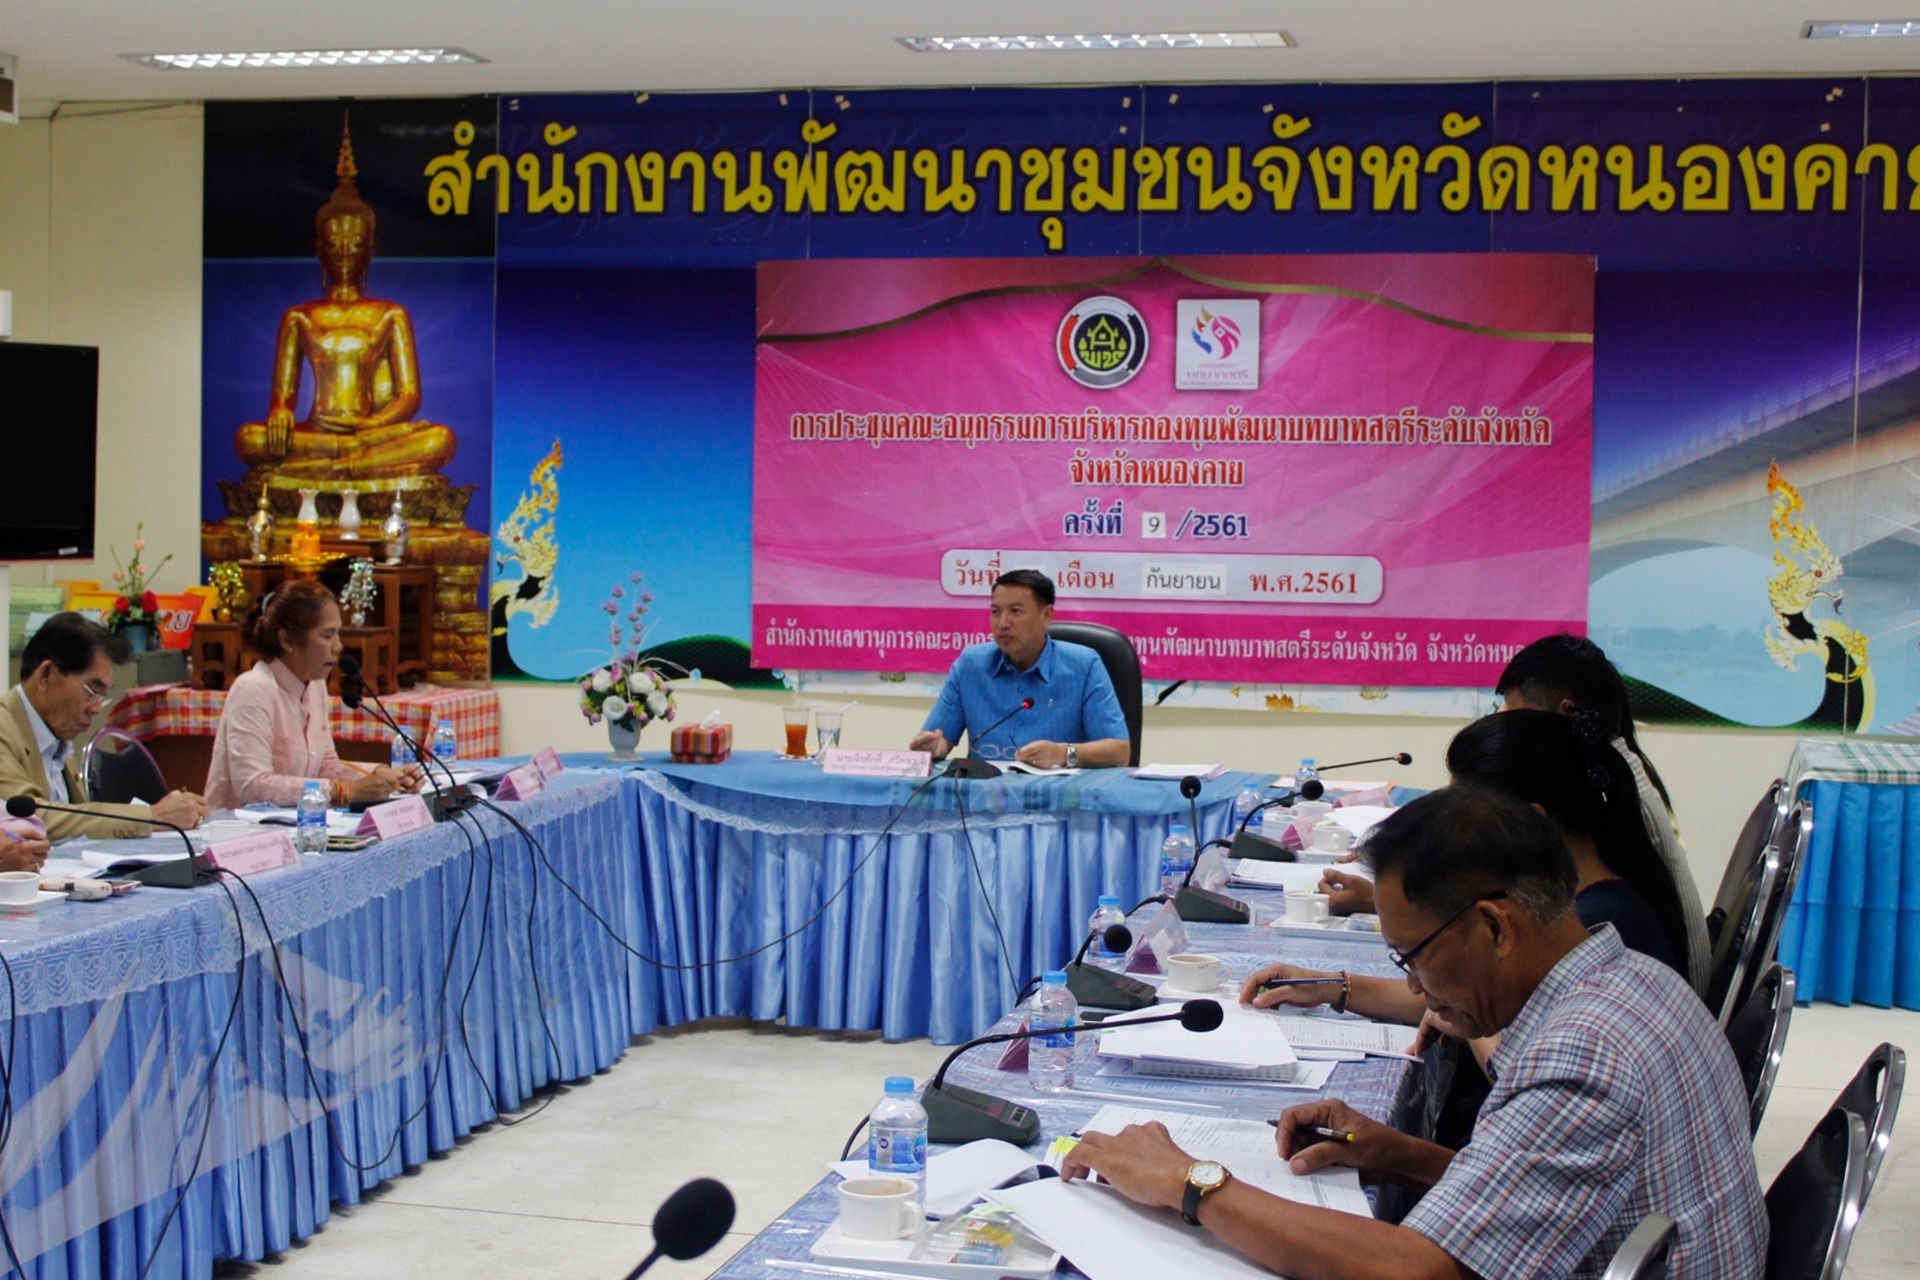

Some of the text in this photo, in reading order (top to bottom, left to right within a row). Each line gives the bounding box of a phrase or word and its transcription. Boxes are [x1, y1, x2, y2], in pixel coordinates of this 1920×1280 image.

[1068, 449, 1244, 487] จังหวัดหนองคาย
[1063, 499, 1124, 537] ครั้งที่
[1057, 559, 1115, 589] เดือน
[1146, 566, 1222, 591] กันยายน
[1249, 570, 1359, 596] พ.ศ.2561
